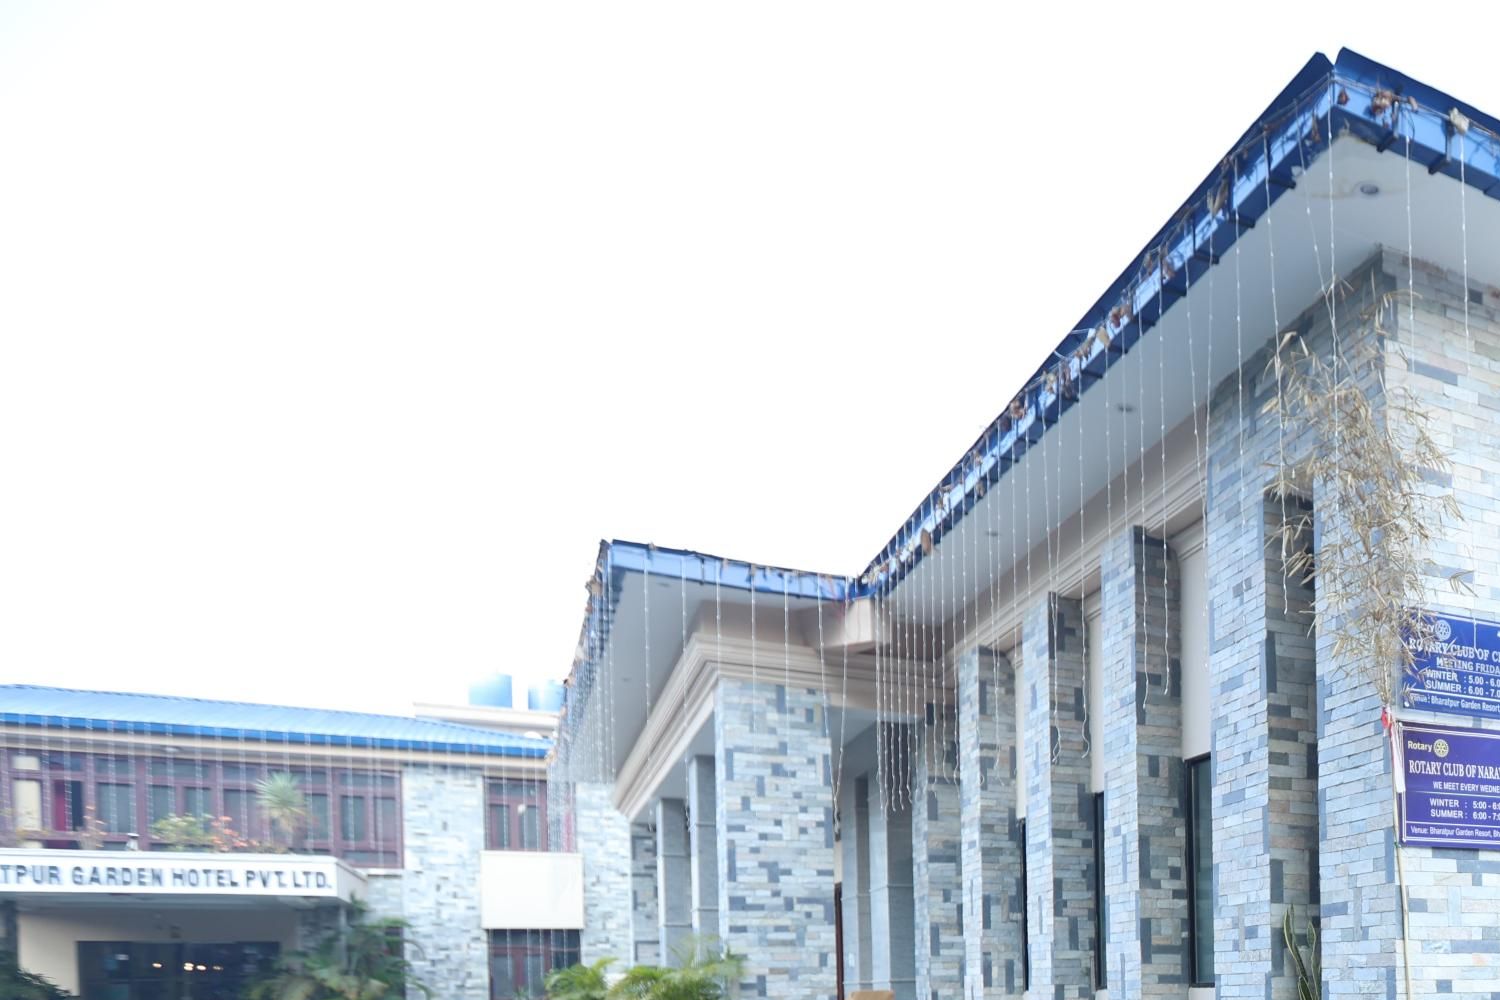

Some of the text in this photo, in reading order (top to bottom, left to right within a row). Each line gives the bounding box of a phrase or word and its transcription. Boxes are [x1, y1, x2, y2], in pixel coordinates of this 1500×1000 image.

[1450, 644, 1475, 659] CLUB
[1476, 648, 1490, 661] OF
[1436, 656, 1474, 671] MEETING
[1426, 668, 1459, 682] WINTER
[1468, 675, 1484, 686] 5.00
[1425, 679, 1462, 693] SUMMER
[1468, 685, 1484, 696] 6.00
[1460, 699, 1481, 710] Garden
[1407, 740, 1433, 753] Rotary
[1408, 759, 1442, 775] ROTARY
[1443, 762, 1465, 777] CLUB
[1465, 764, 1477, 778] OF
[1432, 780, 1443, 790] WE
[1443, 781, 1460, 791] MEET
[1460, 782, 1479, 792] EVERY
[1429, 797, 1460, 808] WINTER
[1472, 800, 1487, 809] 5:00
[1430, 808, 1464, 819] SUMMER
[1472, 811, 1487, 820] 6:00
[1429, 826, 1455, 837] Bharatpur
[1455, 827, 1475, 837] Garden
[71, 866, 164, 887] GARDEN
[172, 868, 239, 888] HOTEL
